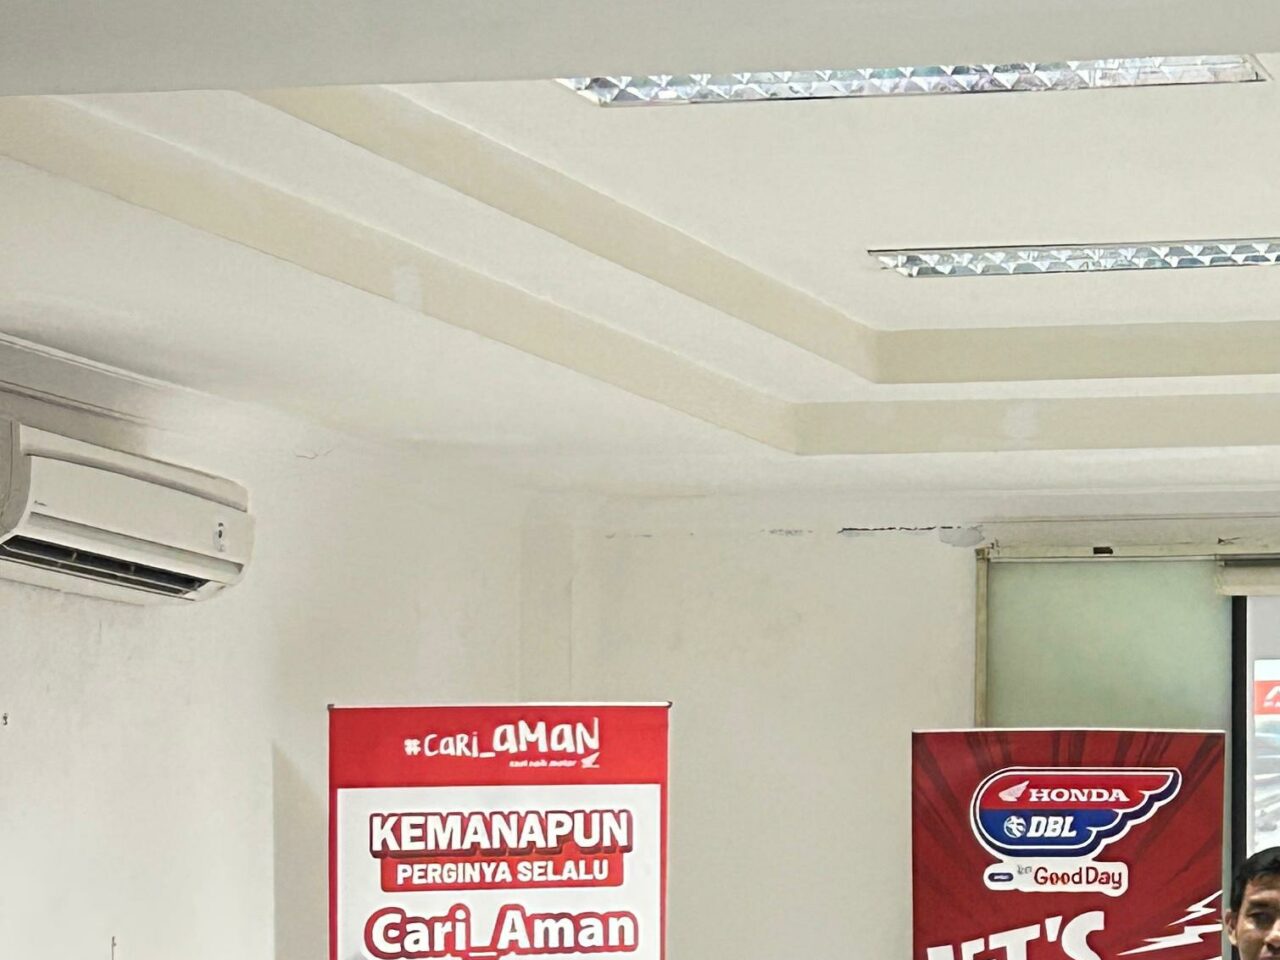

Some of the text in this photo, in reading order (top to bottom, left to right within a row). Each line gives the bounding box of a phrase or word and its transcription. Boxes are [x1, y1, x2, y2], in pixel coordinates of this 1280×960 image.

[1028, 788, 1131, 802] HONDA
[371, 810, 631, 853] KEMANAPUN
[1026, 816, 1077, 838] DBL
[396, 859, 609, 885] PERGINYA SELALU
[1034, 866, 1083, 885] Good
[1086, 866, 1122, 889] Day
[371, 908, 636, 957] Cari_Aman
